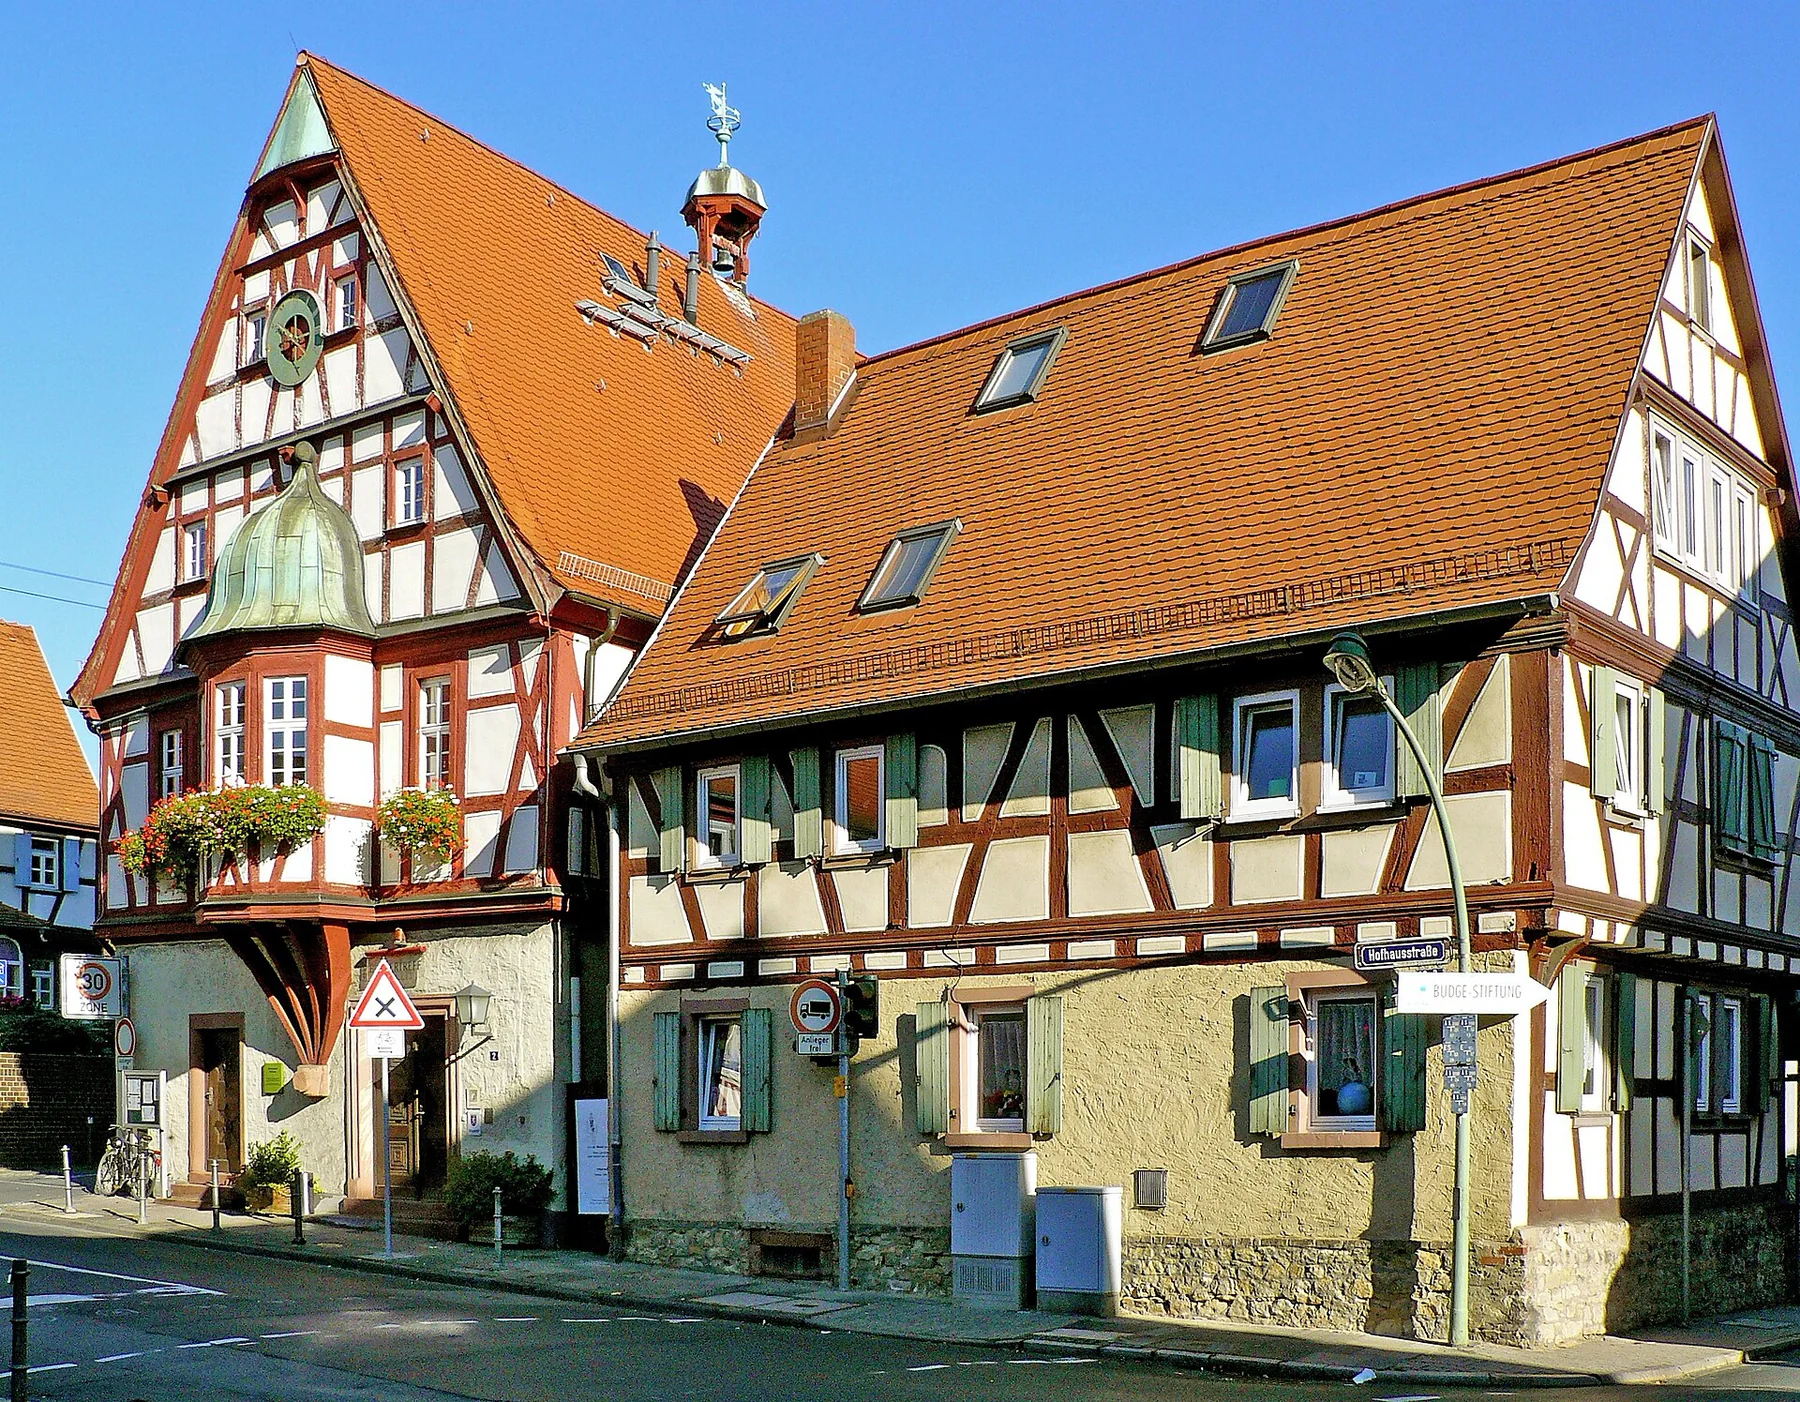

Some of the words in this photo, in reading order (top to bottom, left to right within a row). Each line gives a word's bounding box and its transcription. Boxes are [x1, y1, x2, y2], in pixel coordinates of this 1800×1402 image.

[1368, 944, 1439, 962] Hofhausstraße
[82, 973, 104, 991] 30
[1433, 984, 1522, 999] BUDGE-STIFTUNG
[80, 1002, 108, 1013] ZONE
